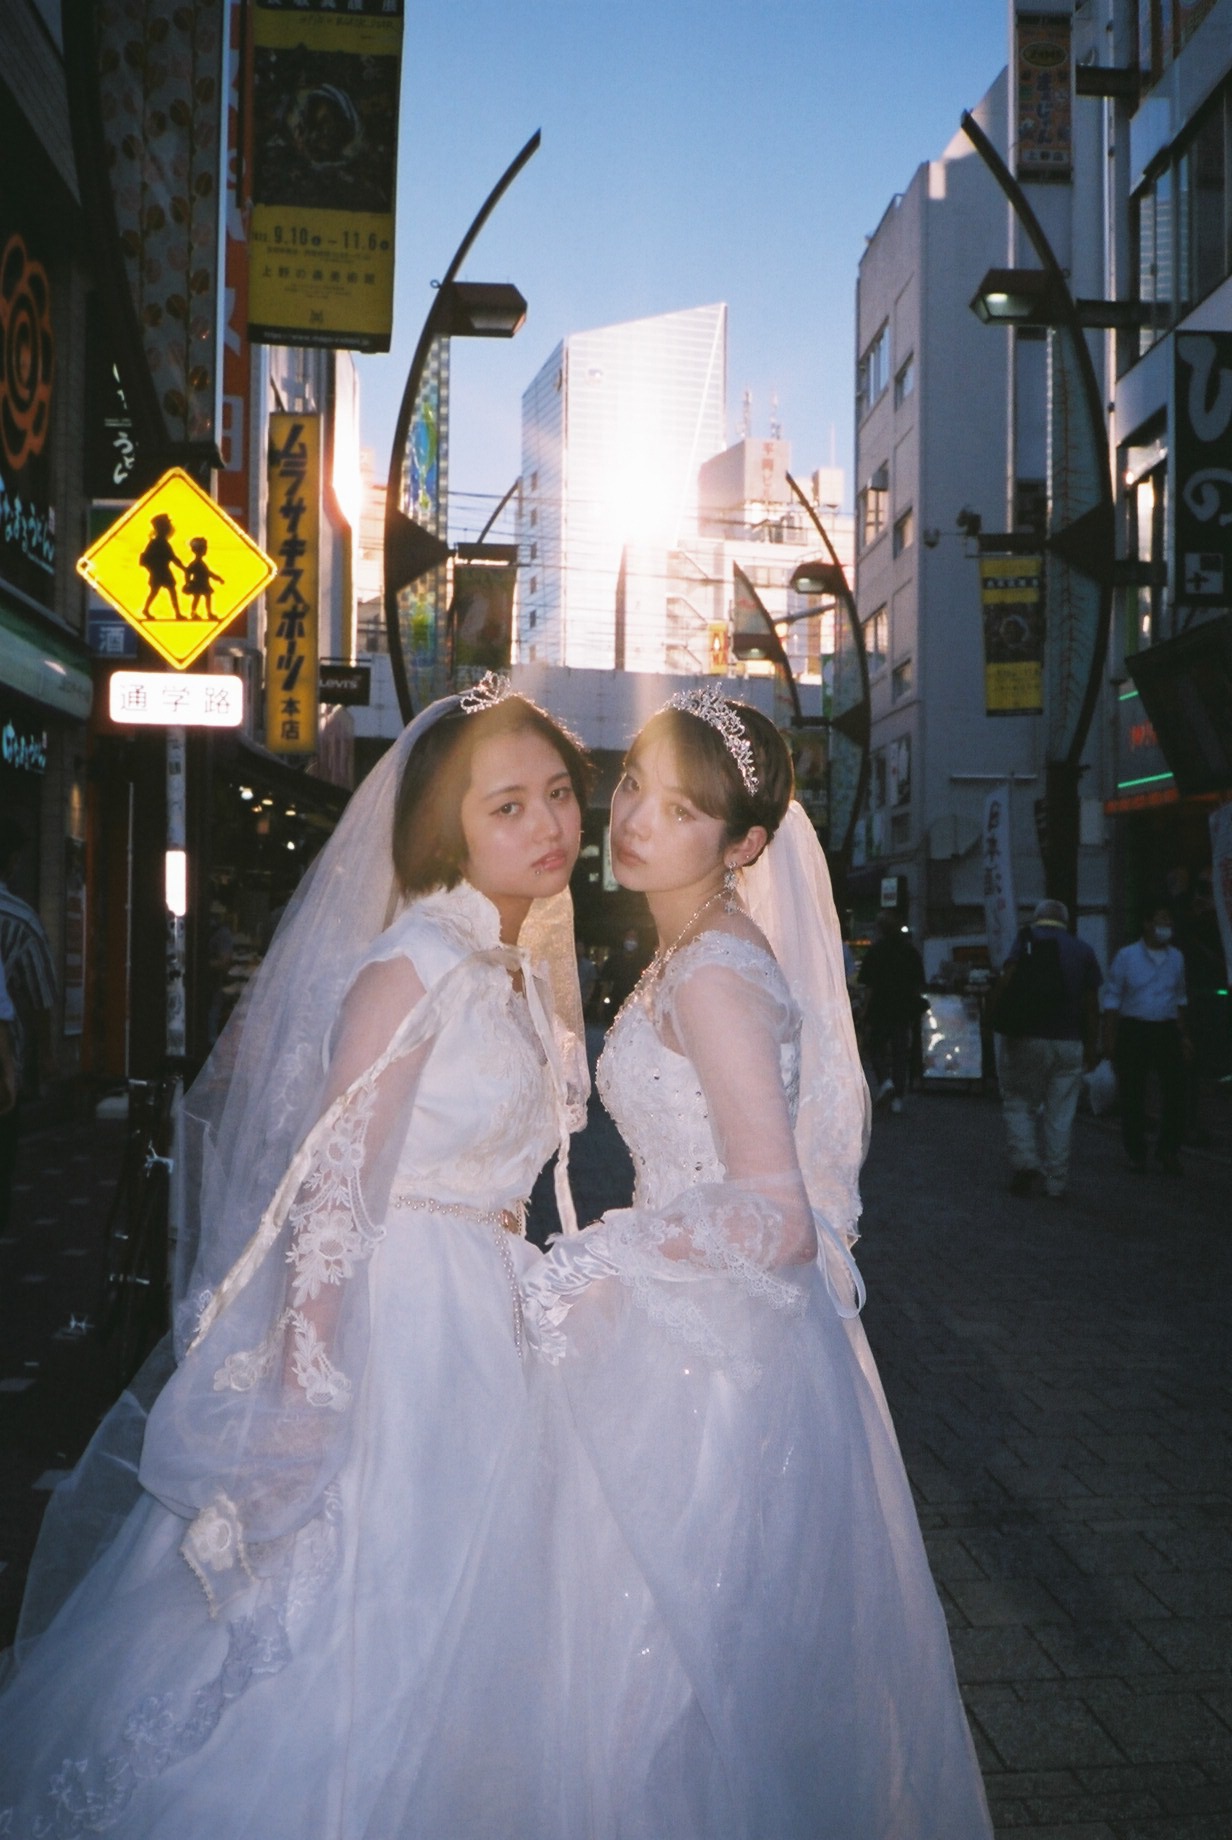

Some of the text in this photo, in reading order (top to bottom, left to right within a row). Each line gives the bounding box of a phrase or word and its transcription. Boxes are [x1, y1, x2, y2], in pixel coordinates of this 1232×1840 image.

[276, 424, 310, 691] ムラサキスポーツ
[99, 626, 125, 653] 酒
[120, 683, 231, 714] 通学路
[280, 696, 302, 740] 本店
